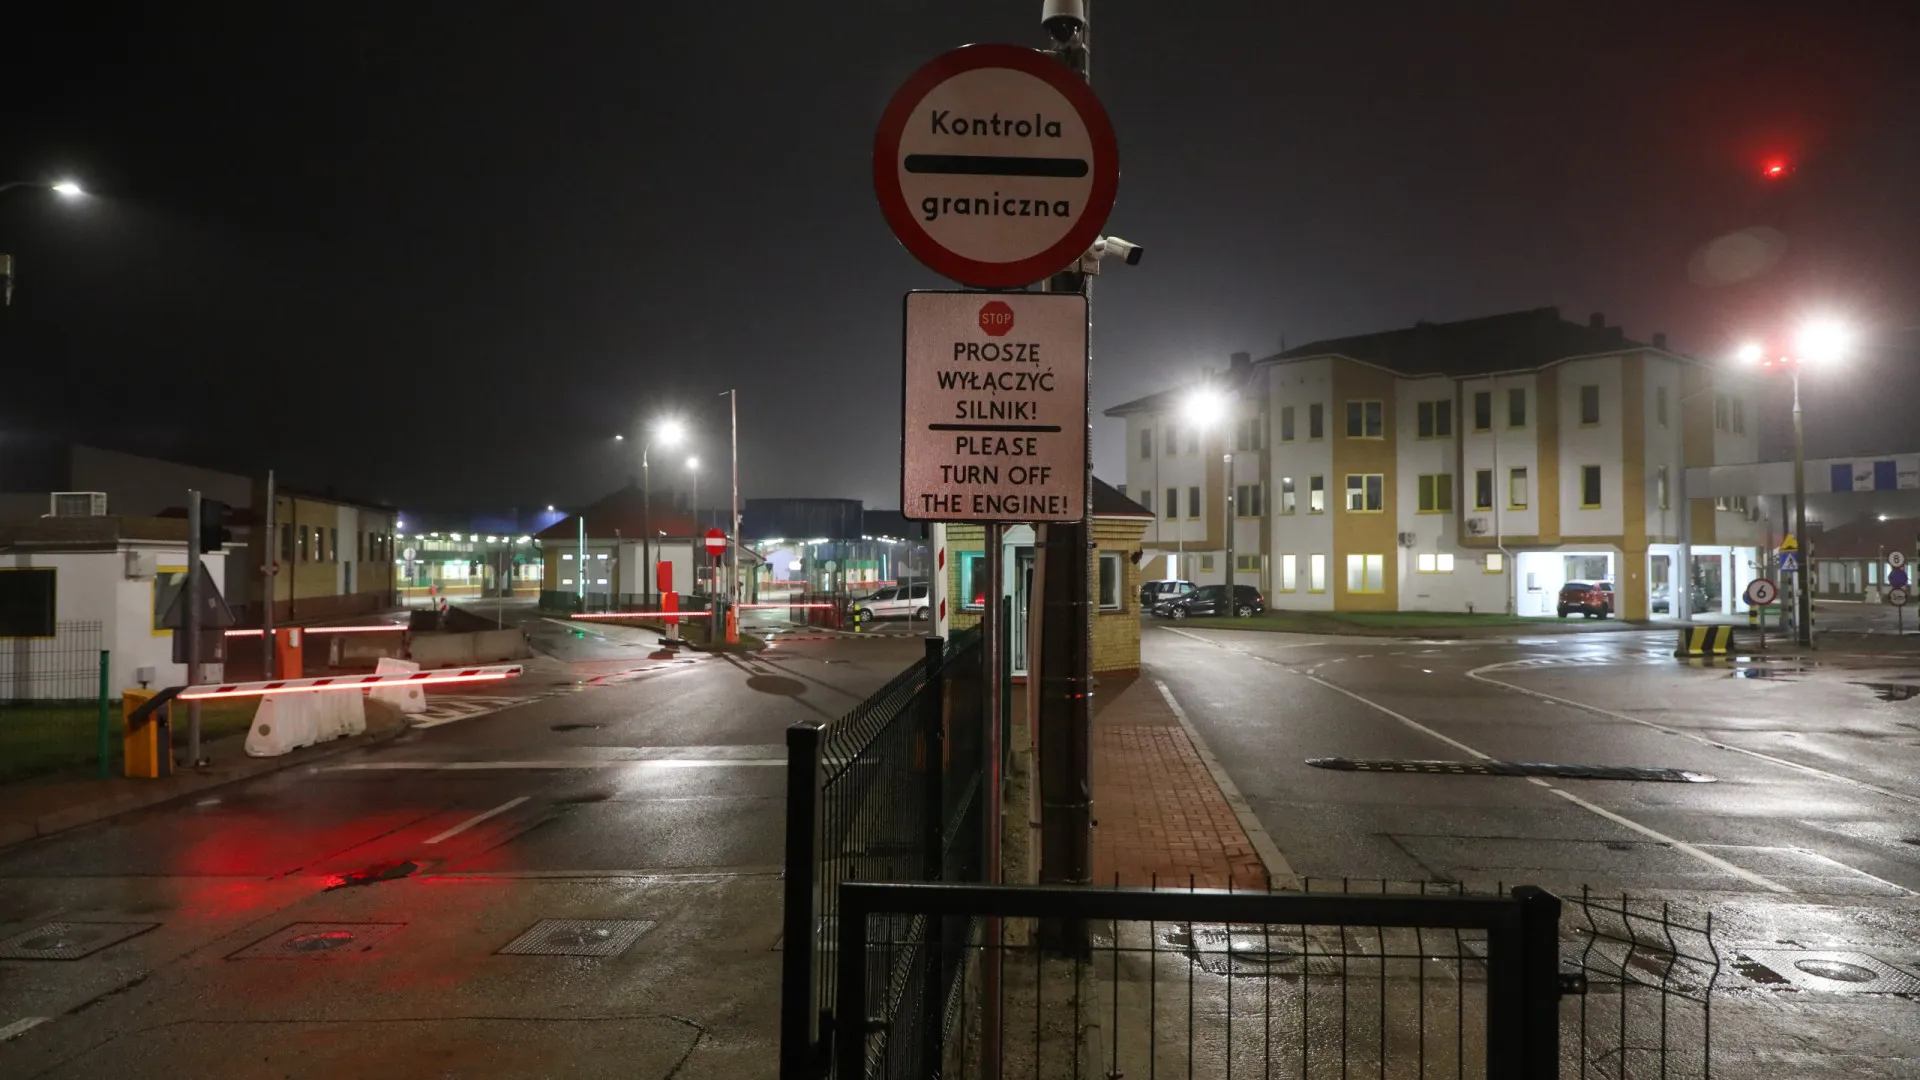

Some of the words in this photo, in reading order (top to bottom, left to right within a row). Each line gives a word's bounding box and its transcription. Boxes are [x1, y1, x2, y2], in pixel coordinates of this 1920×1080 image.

[931, 110, 1062, 138] Kontrola
[921, 191, 1070, 222] graniczna
[982, 313, 1011, 325] STOP
[937, 367, 1054, 396] WYŁĄCZYĆ
[955, 400, 1037, 420] SILNIK!
[956, 436, 1037, 456] PLEASE
[940, 465, 998, 485] TURN
[1008, 466, 1052, 486] OFF
[921, 494, 962, 513] THE
[973, 495, 1068, 514] ENGINE!
[1756, 585, 1766, 599] 6
